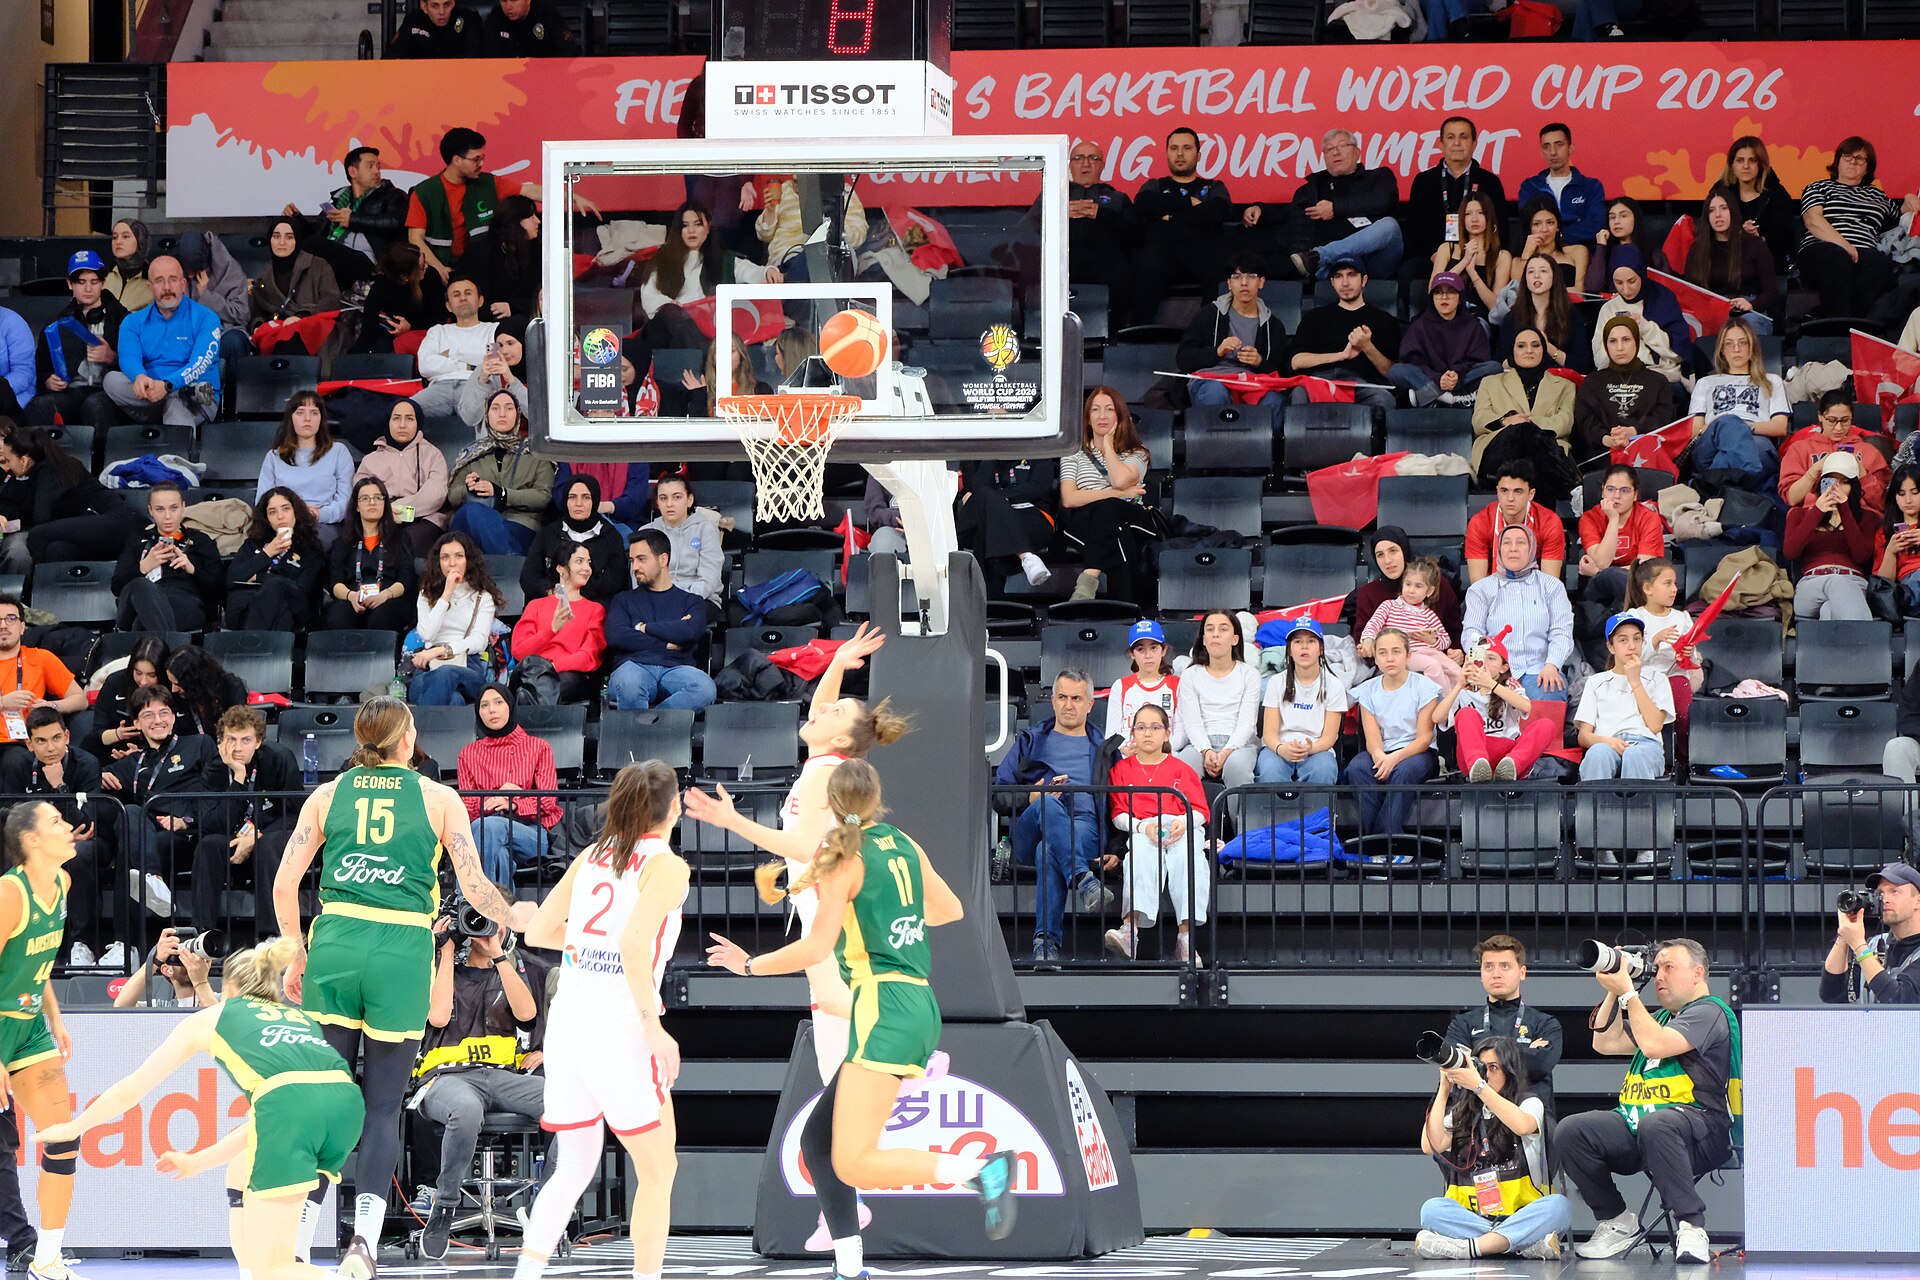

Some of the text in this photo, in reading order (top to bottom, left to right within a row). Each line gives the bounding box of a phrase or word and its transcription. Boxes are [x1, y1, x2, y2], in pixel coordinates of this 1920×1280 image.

[781, 84, 896, 105] TISSOT
[1014, 67, 1316, 119] BASKETBALL
[1336, 65, 1512, 112] WORLD
[1531, 63, 1643, 111] CUP
[1656, 68, 1784, 111] 2026
[734, 108, 896, 116] SWISS WATCHES SINCE 1853
[586, 373, 616, 389] FIBA
[962, 388, 1037, 396] WORLD CUP 2026
[353, 775, 404, 790] GEORGE
[354, 797, 395, 845] 15
[333, 852, 406, 885] Ford
[588, 847, 647, 872] UZN
[887, 856, 914, 907] 11
[582, 881, 615, 937] 2
[888, 914, 926, 950] Ford
[467, 1044, 492, 1062] HR
[1794, 1066, 1920, 1171] he
